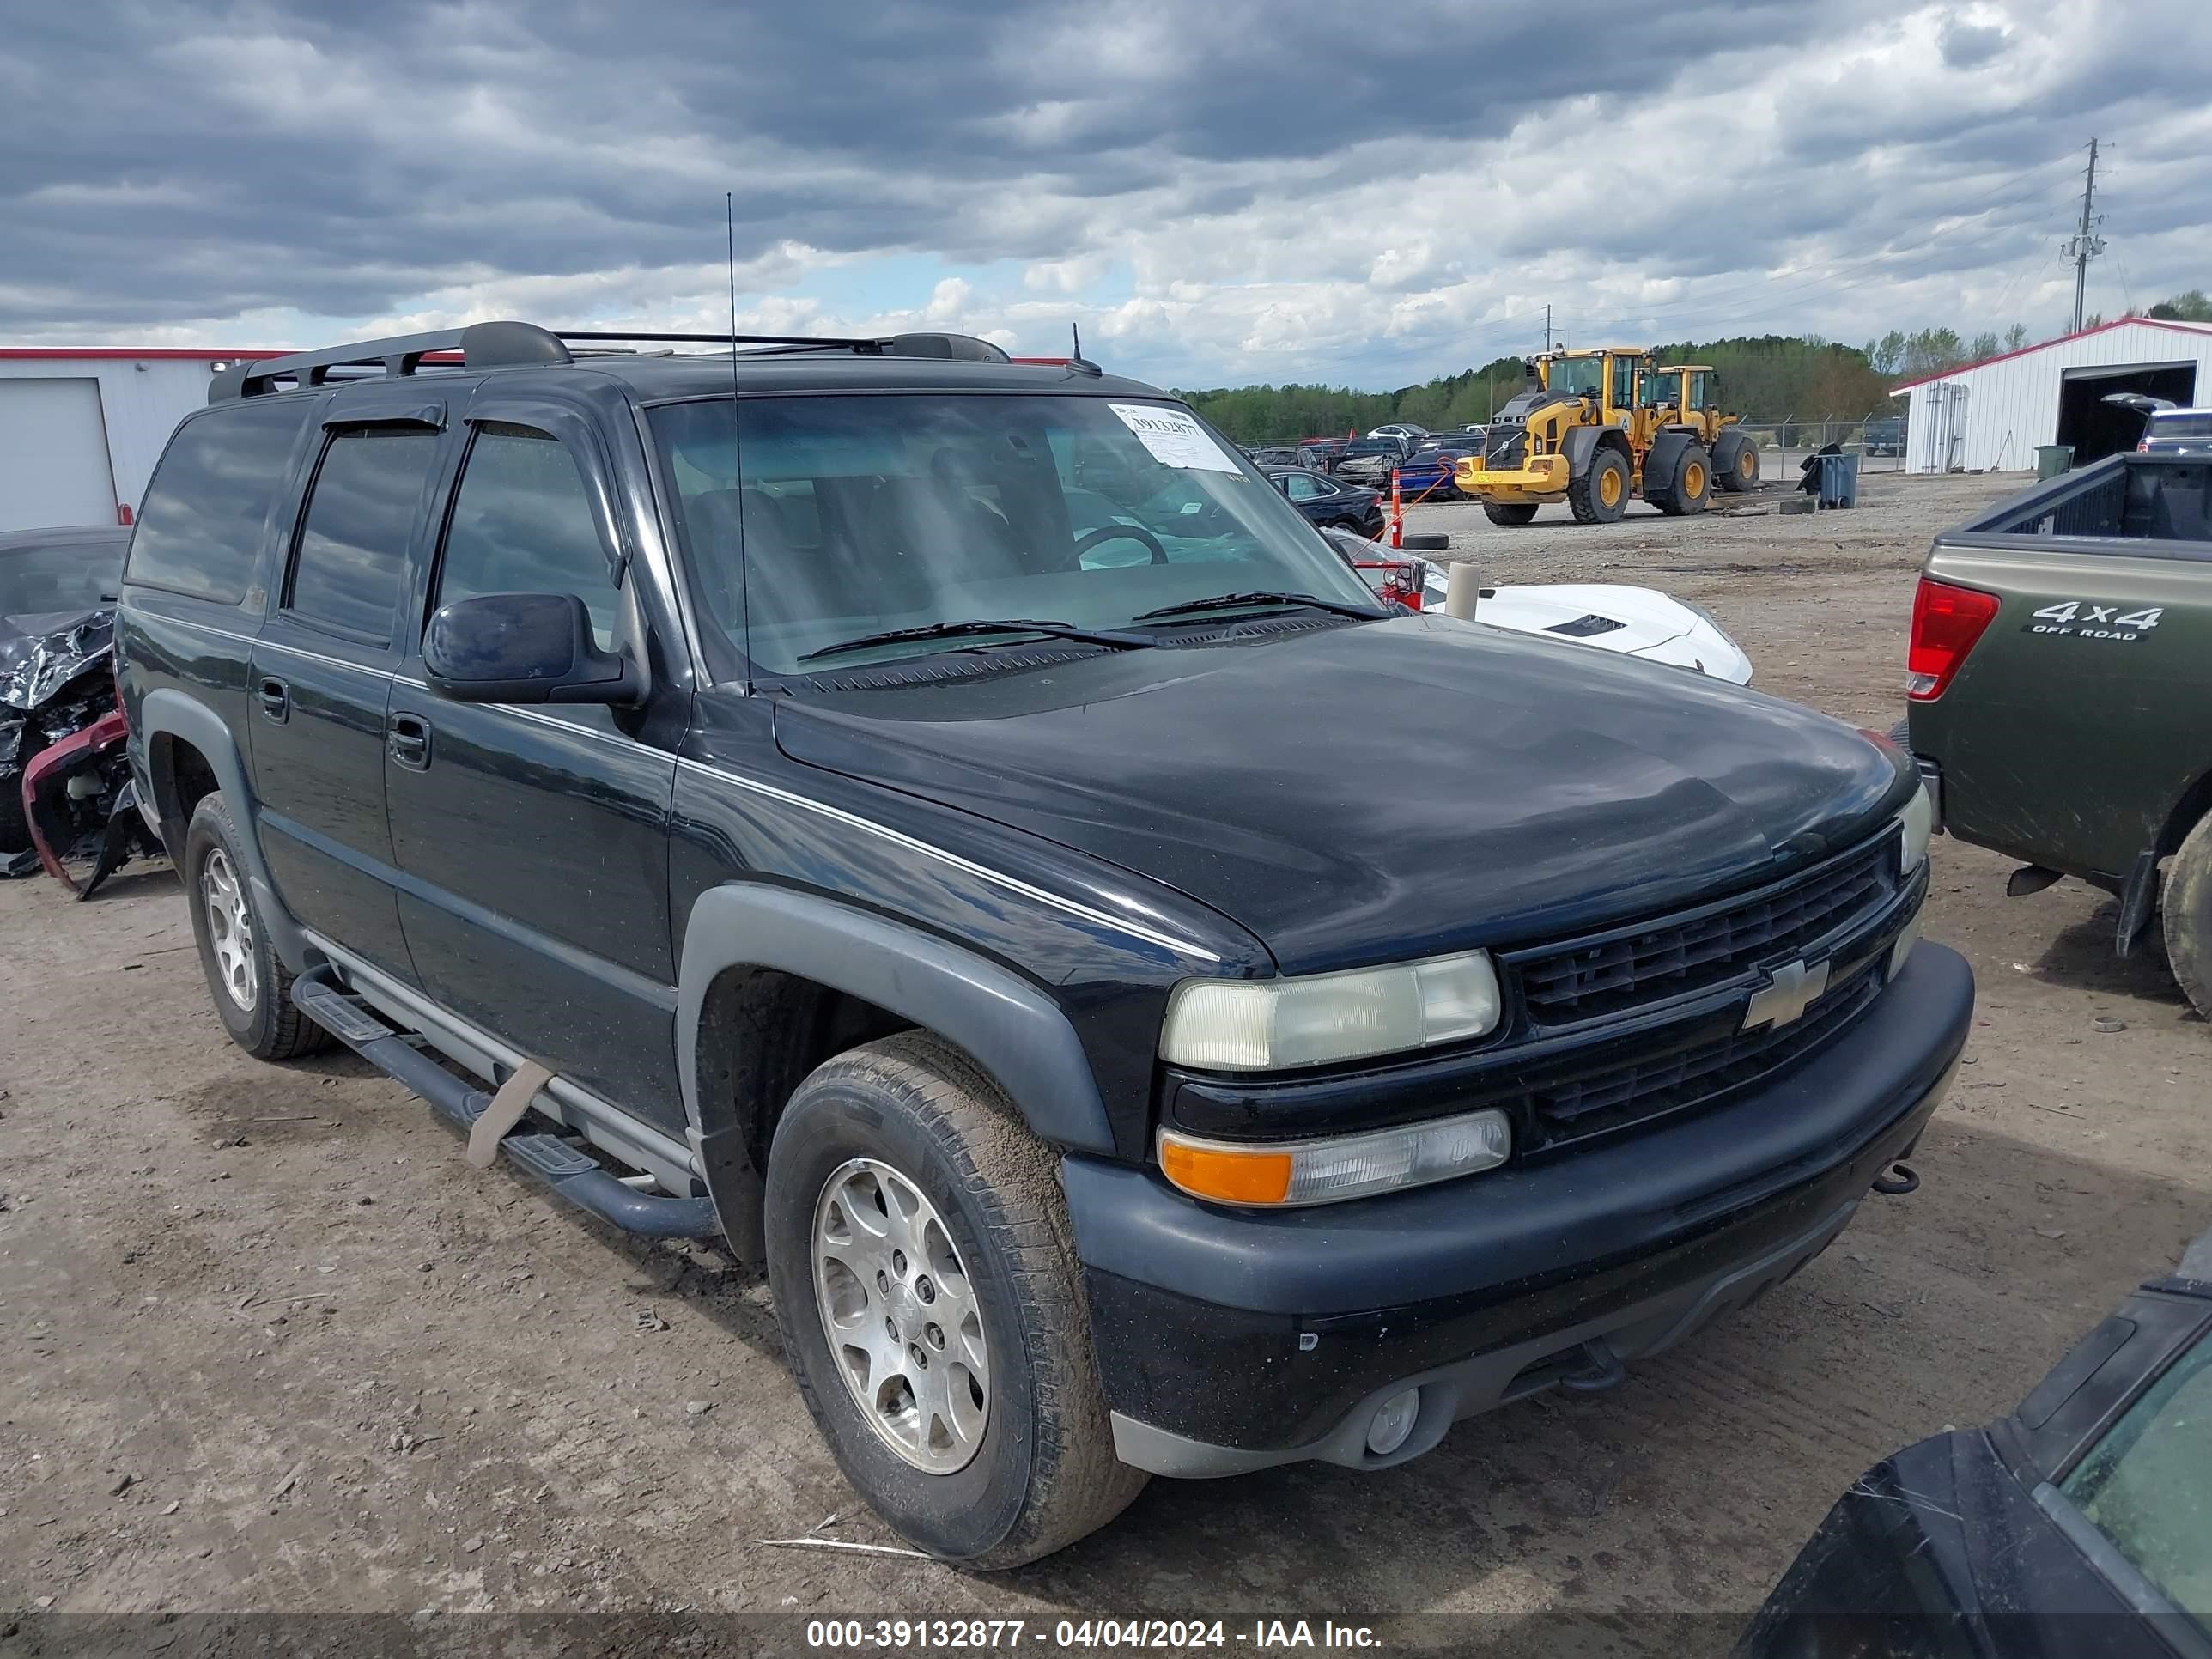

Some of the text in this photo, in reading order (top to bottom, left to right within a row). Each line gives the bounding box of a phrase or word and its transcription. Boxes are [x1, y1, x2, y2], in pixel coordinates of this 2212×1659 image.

[1132, 417, 1200, 437] 39132877
[2032, 625, 2137, 641] OFF ROAD
